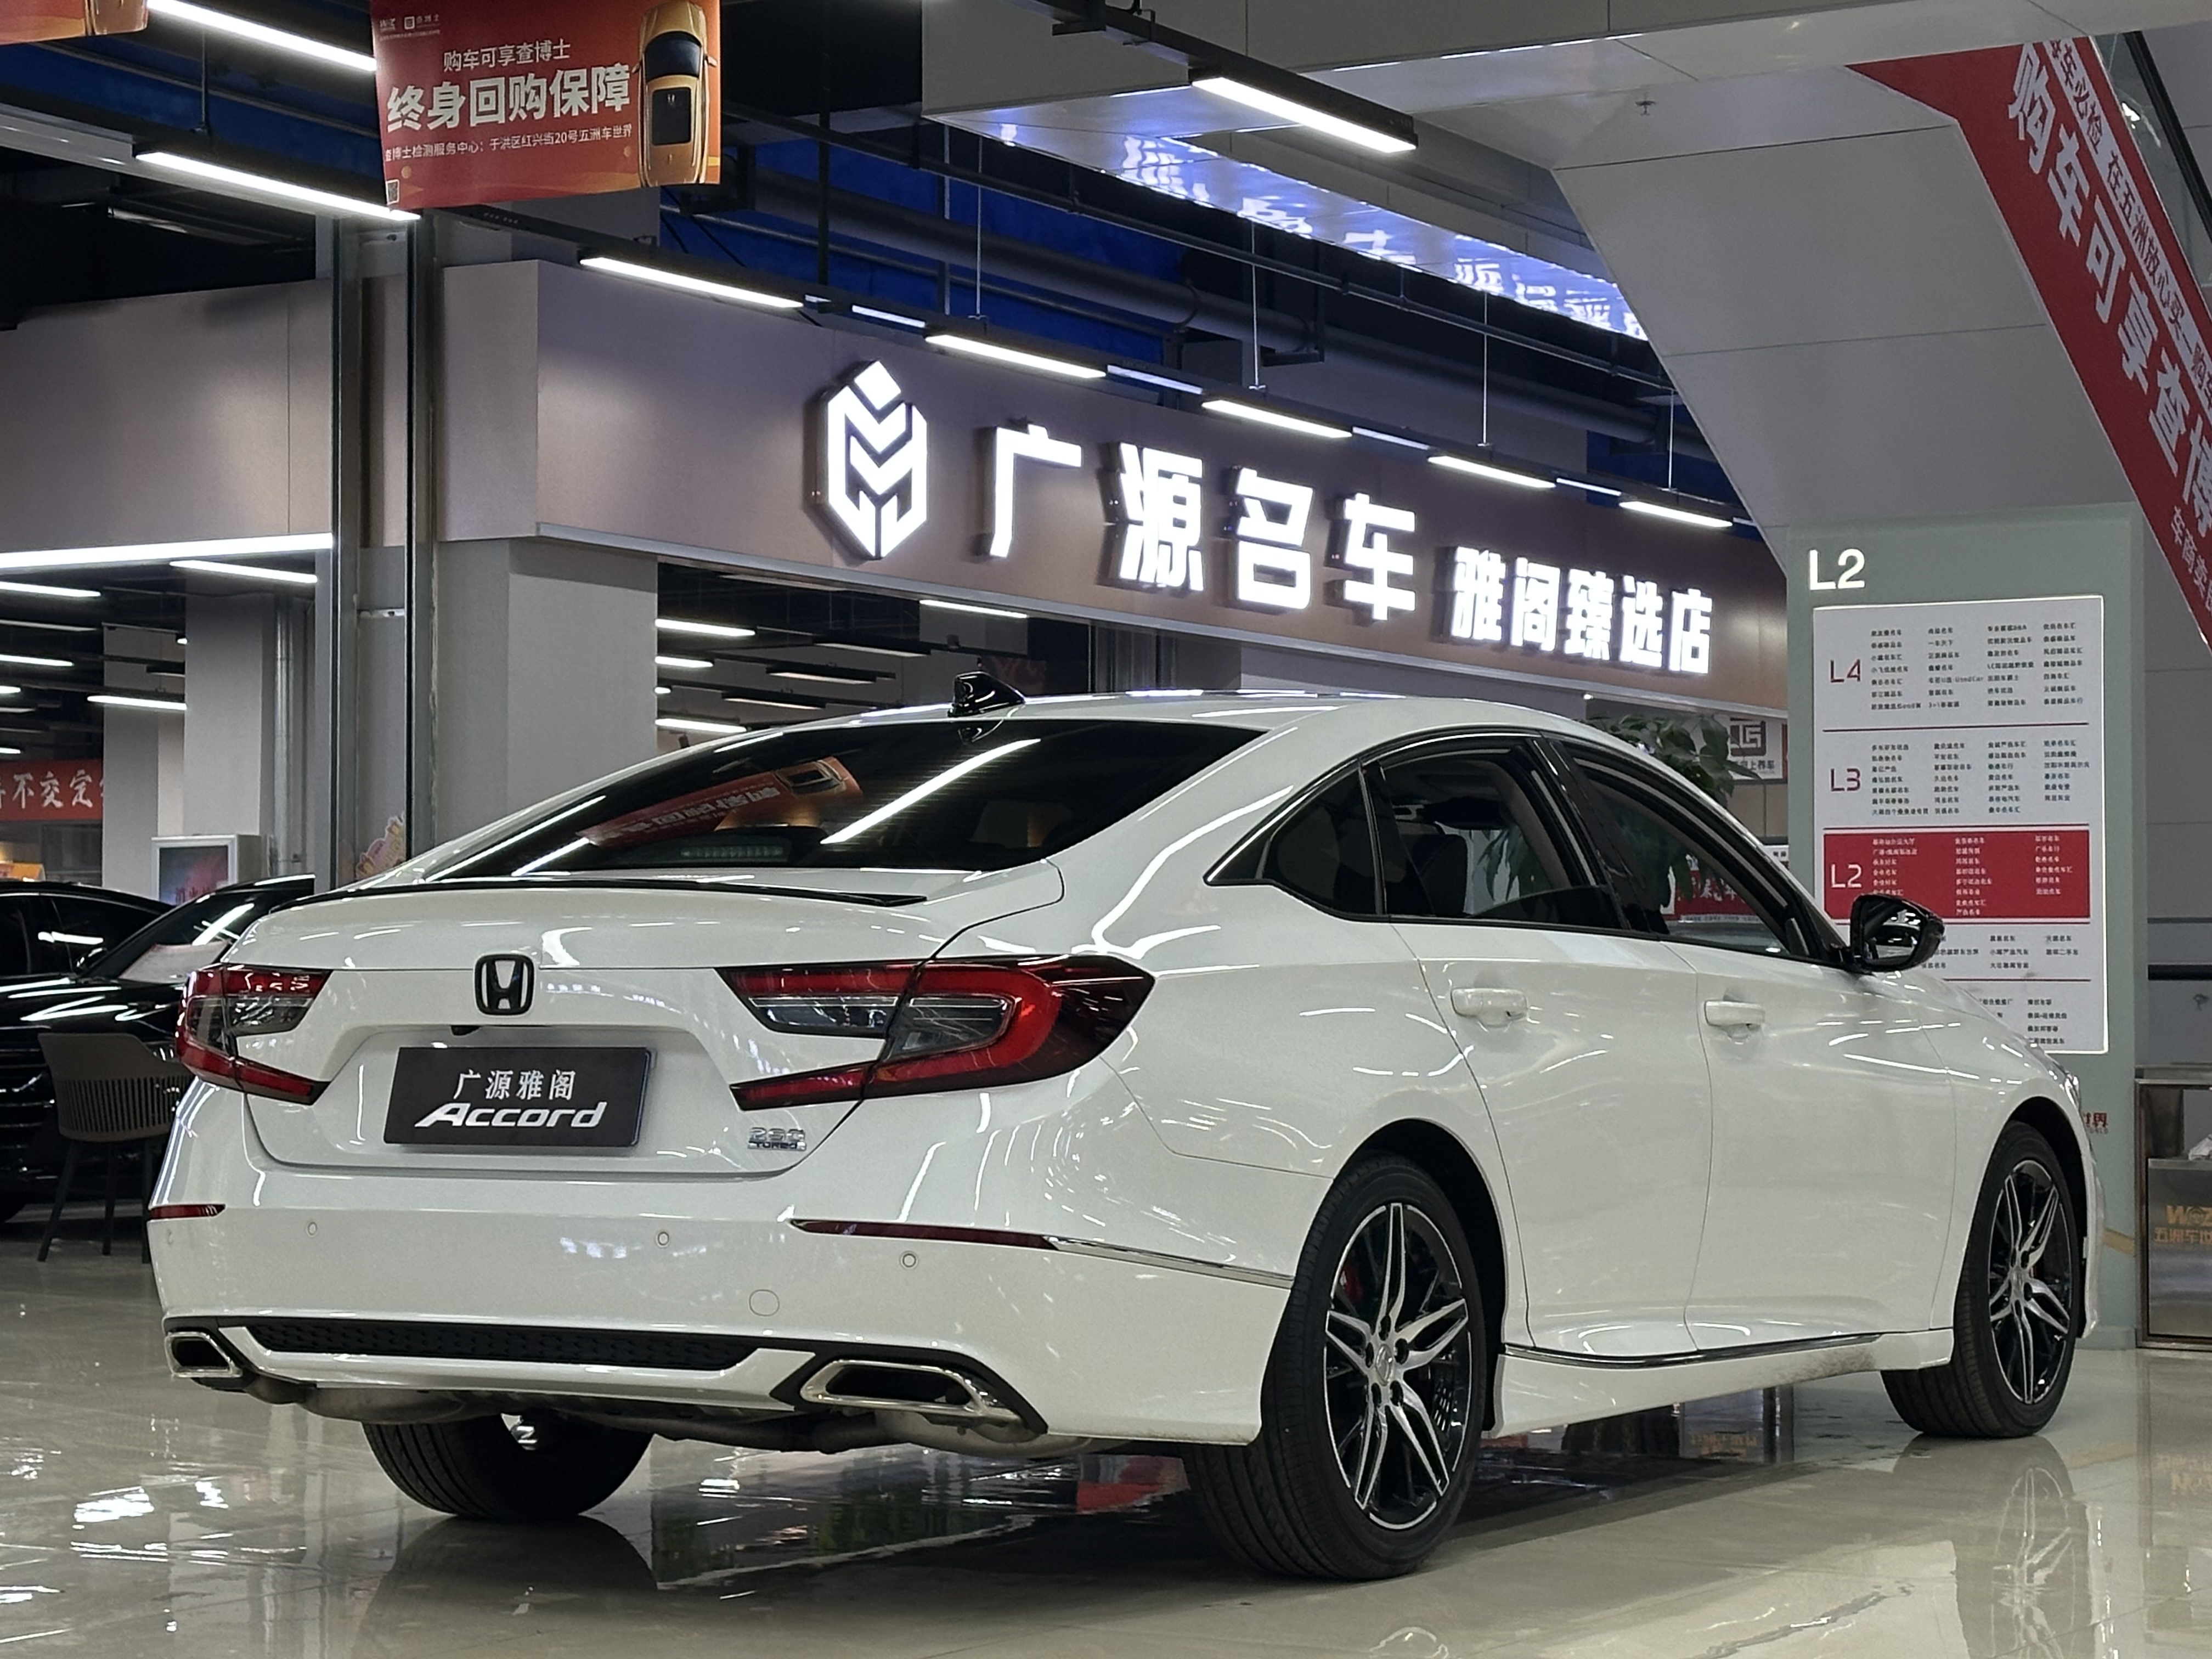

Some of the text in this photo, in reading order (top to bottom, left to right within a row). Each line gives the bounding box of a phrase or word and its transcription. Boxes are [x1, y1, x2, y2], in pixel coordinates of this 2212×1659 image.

[444, 38, 571, 72] 购车可享查博士
[387, 63, 630, 133] 终身回购保障
[990, 424, 1416, 620] 广源名车
[1450, 546, 1713, 674] 雅阁臻选店
[1810, 549, 1865, 590] L2
[1830, 659, 1861, 683] L4
[1830, 769, 1861, 792] L3
[1831, 864, 1862, 888] L2
[453, 1069, 576, 1101] 广源雅阁
[414, 1102, 607, 1127] Accord
